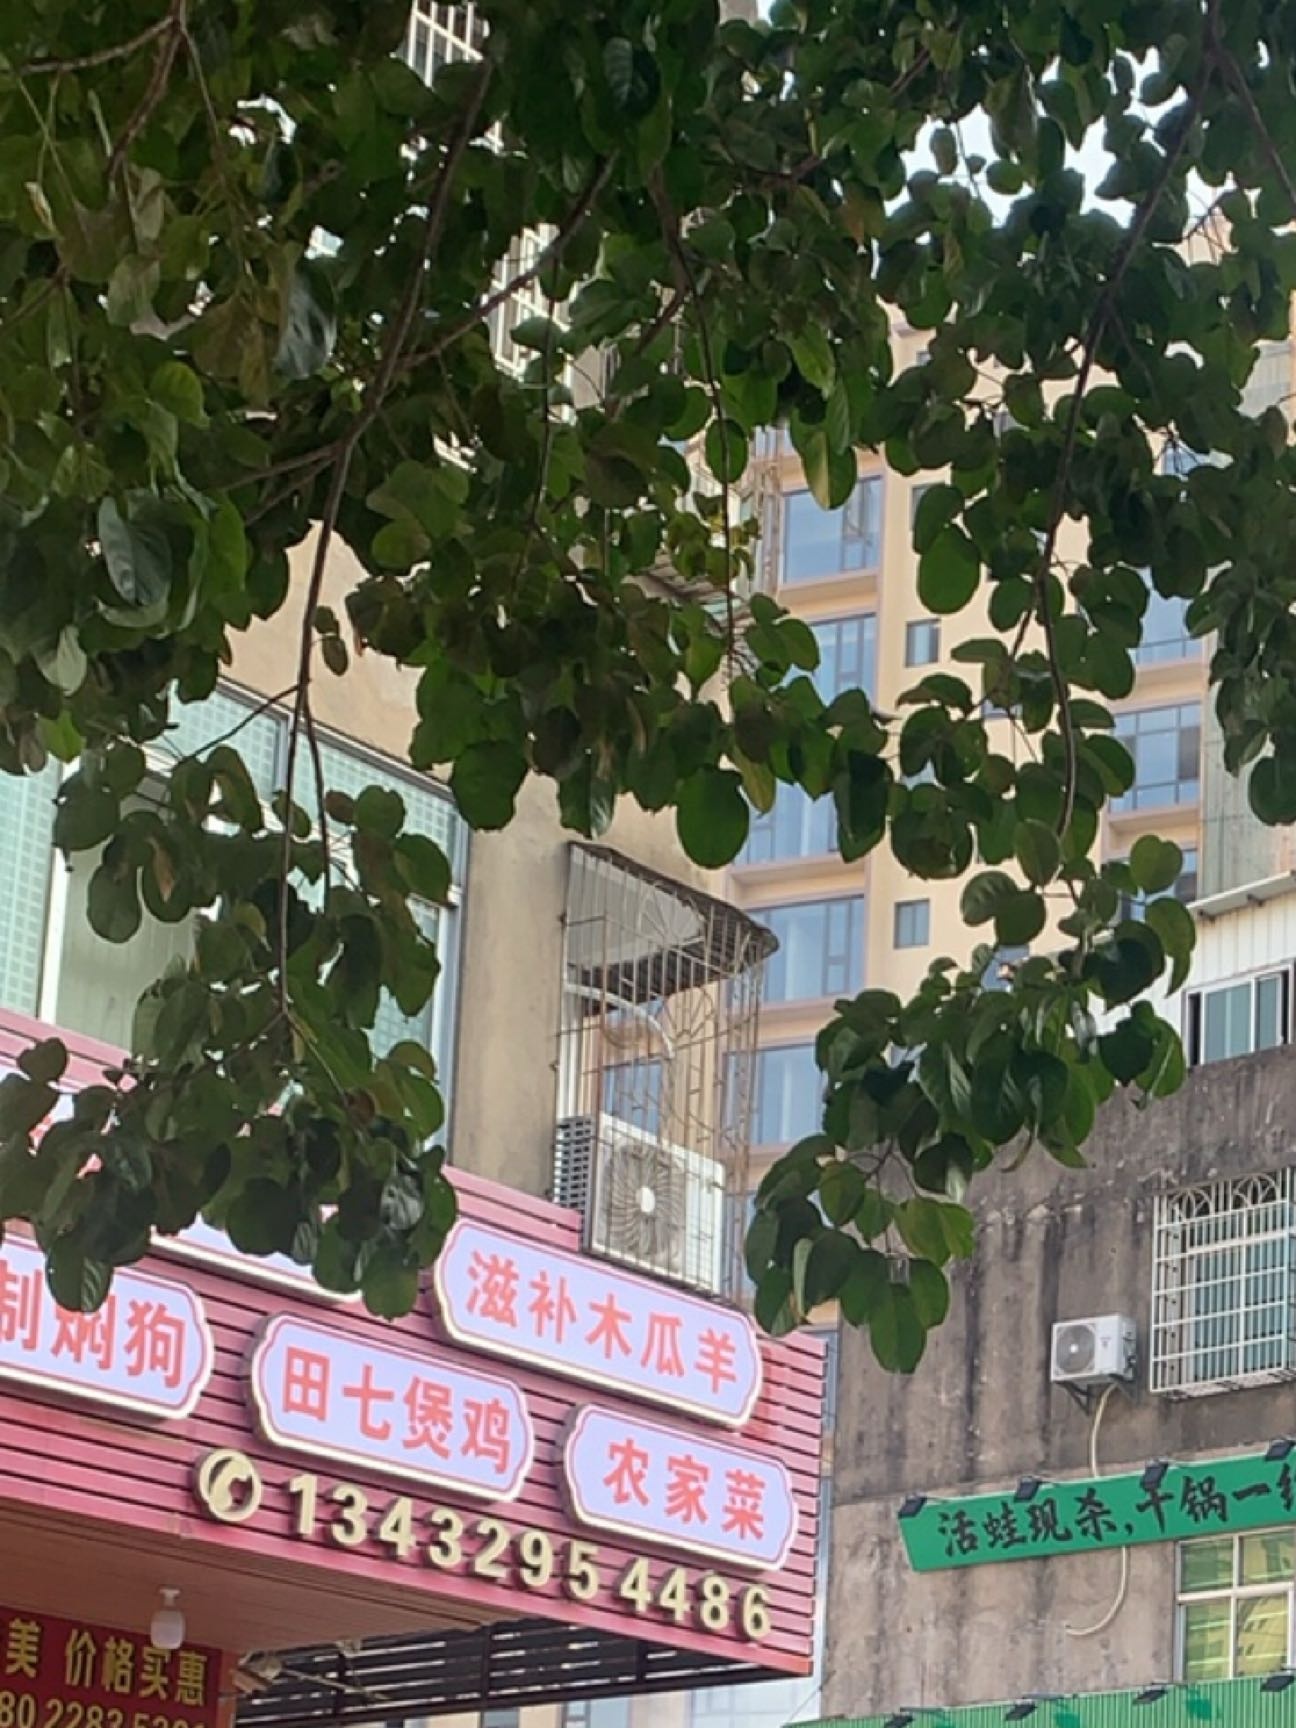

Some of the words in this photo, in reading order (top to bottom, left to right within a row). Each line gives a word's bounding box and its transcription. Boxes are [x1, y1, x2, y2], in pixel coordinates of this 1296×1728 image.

[465, 1249, 737, 1396] 滋补木瓜羊
[281, 1346, 513, 1475] 田七煲鸡
[602, 1437, 768, 1542] 农家菜
[288, 1471, 774, 1641] 13432954486
[5, 1617, 42, 1679] 美
[64, 1628, 208, 1707] 价格实惠
